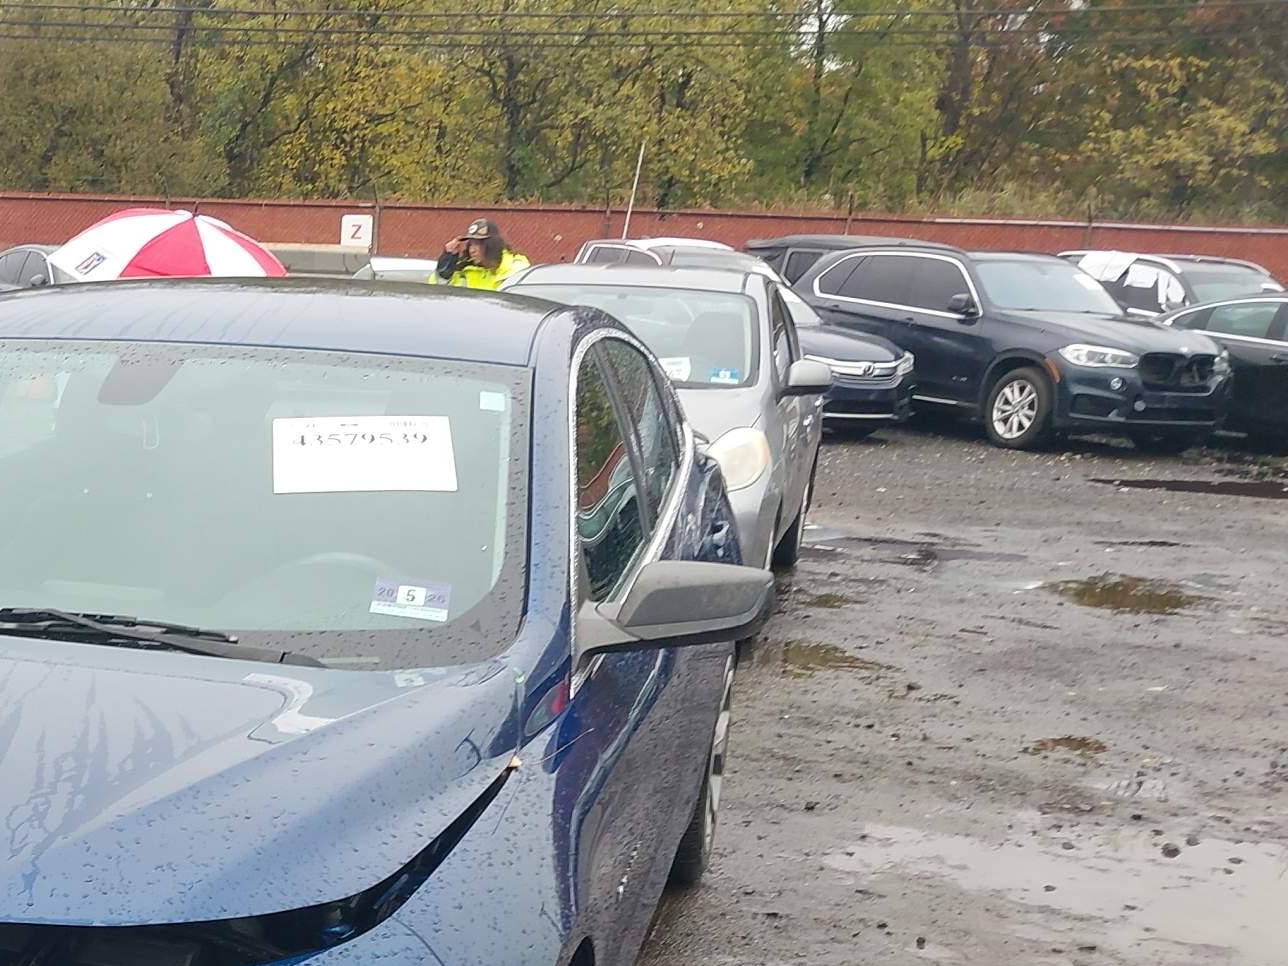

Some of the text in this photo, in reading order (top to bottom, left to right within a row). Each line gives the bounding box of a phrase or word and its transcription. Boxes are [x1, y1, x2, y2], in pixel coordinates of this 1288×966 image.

[350, 224, 363, 240] Z
[291, 432, 428, 447] 43579539
[406, 589, 417, 602] 5
